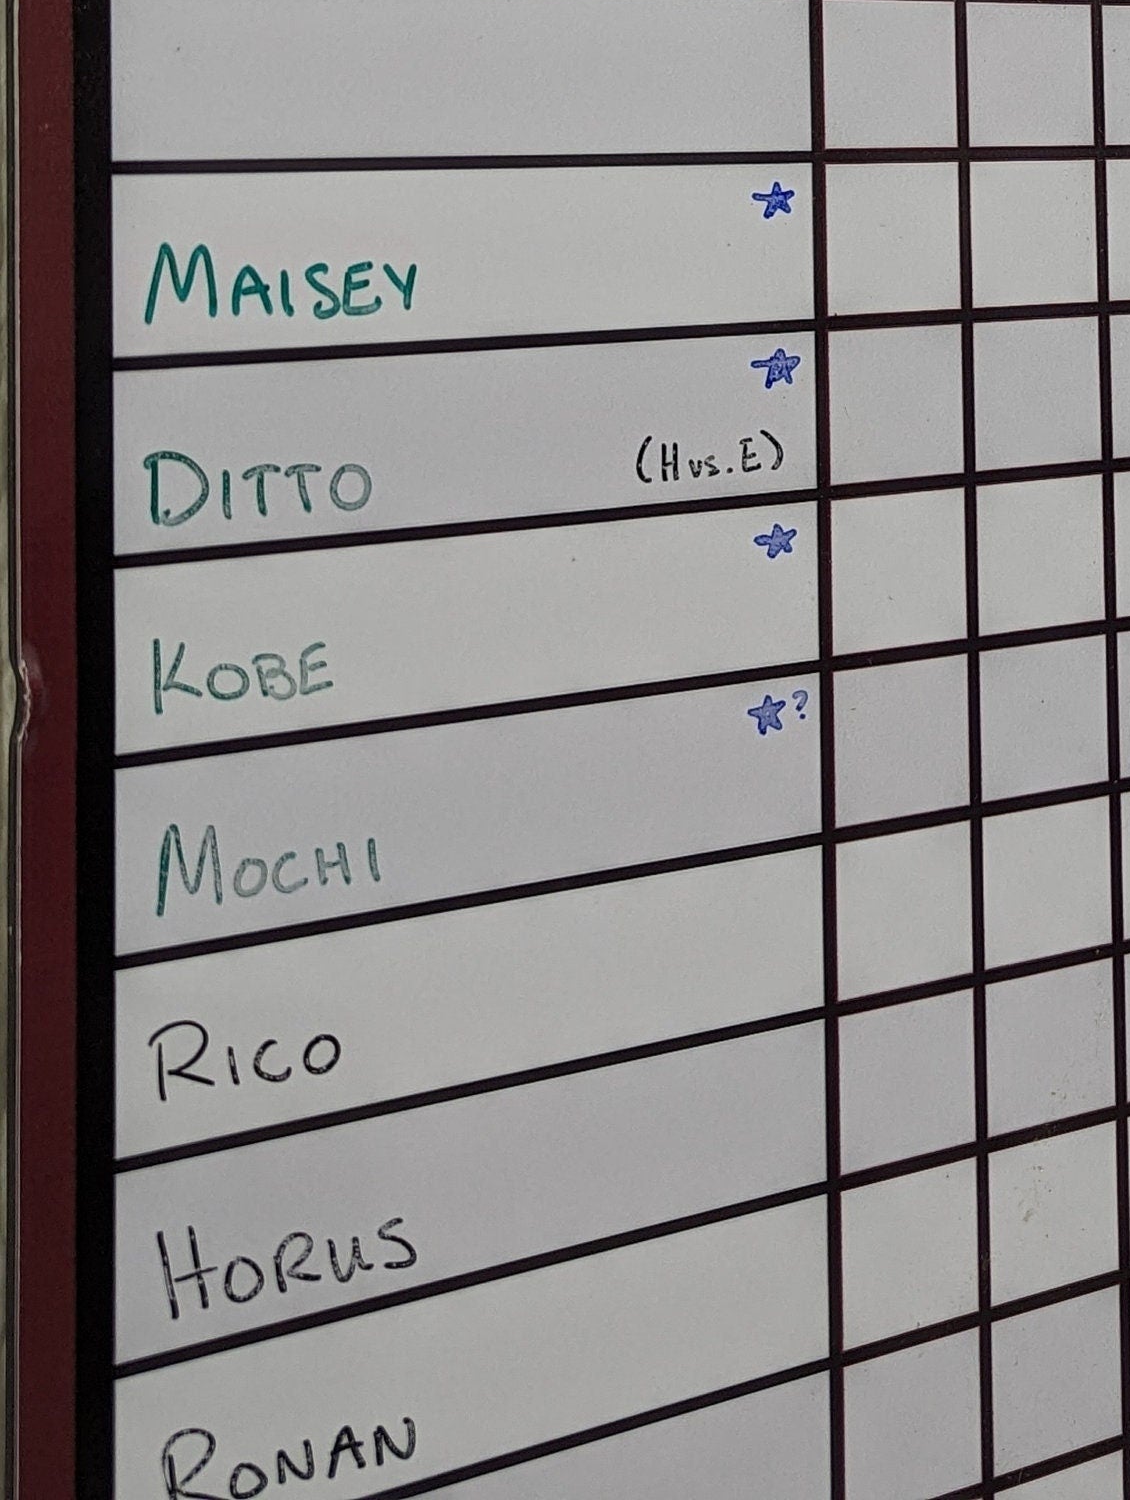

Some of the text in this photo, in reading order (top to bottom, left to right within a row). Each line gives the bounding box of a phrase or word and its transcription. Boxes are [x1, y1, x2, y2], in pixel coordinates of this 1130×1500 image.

[144, 242, 418, 326] MAISEY
[143, 450, 373, 528] DITTO
[152, 637, 334, 716] KOBE
[790, 689, 810, 722] ?
[155, 822, 383, 918] MOCHI
[148, 1020, 343, 1102] RICO
[155, 1217, 418, 1320] HORUS
[161, 1415, 417, 1500] RONAN
